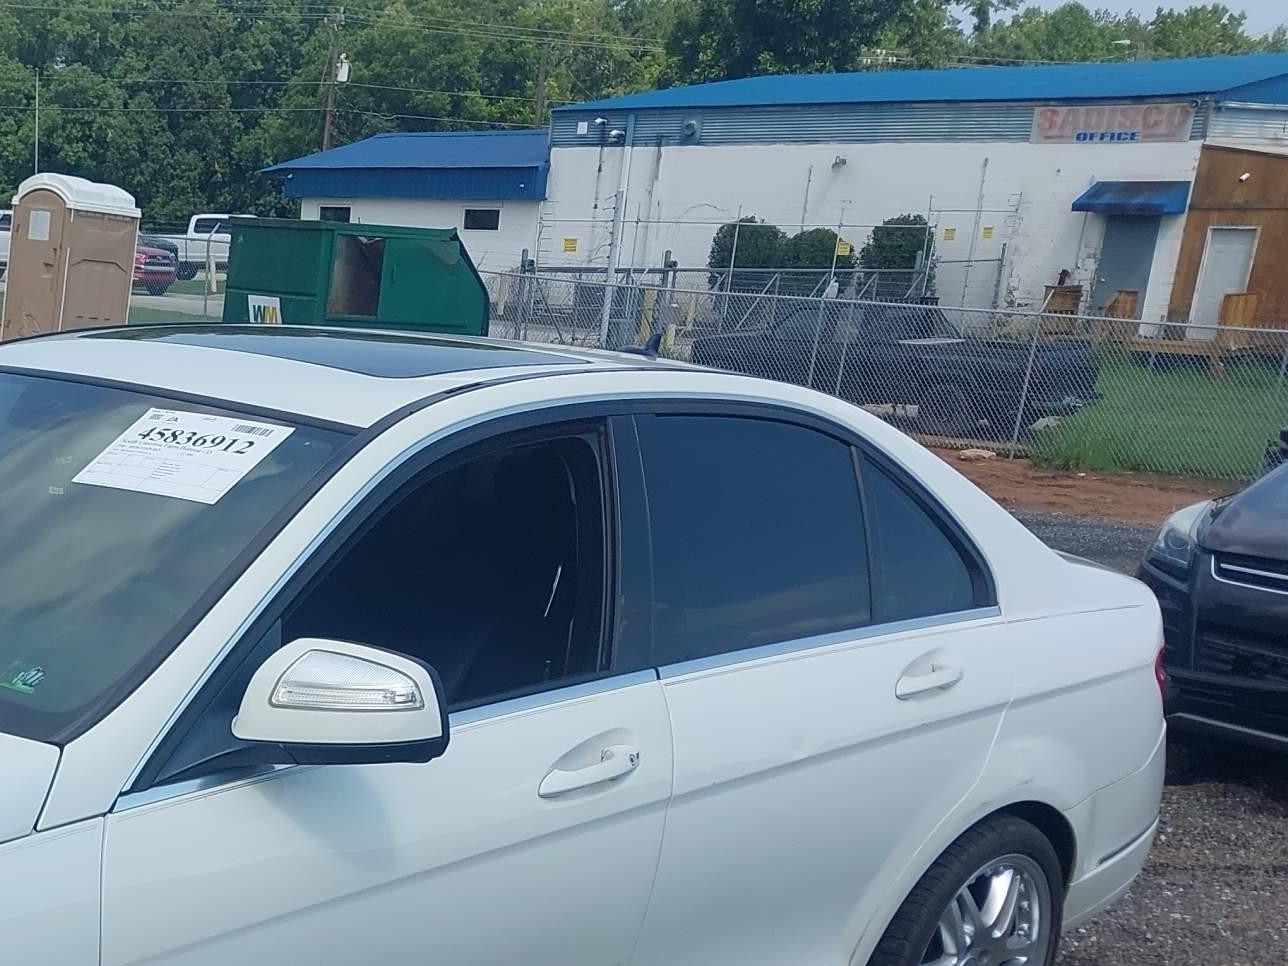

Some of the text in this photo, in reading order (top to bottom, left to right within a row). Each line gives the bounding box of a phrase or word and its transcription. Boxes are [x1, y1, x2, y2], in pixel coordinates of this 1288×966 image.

[1038, 105, 1193, 131] SADISCO
[1075, 131, 1141, 142] OFFICE
[252, 304, 278, 323] WM
[138, 426, 255, 455] 45836912
